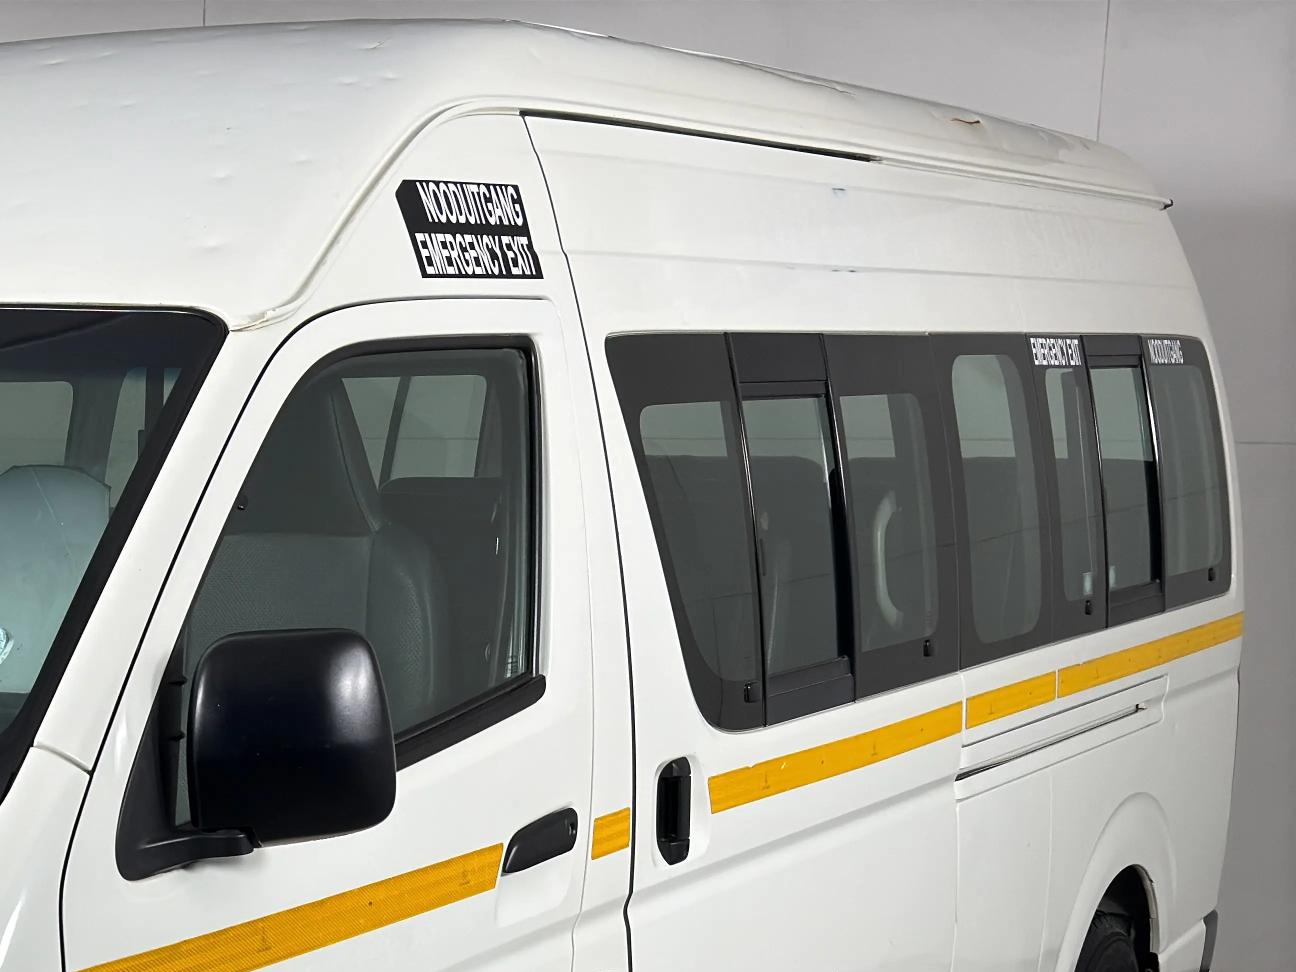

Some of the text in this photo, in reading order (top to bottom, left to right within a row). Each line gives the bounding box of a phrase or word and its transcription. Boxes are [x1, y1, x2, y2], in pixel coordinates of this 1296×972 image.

[415, 181, 524, 227] NOODUITGANG
[414, 232, 537, 276] EMERGENCY EXIT
